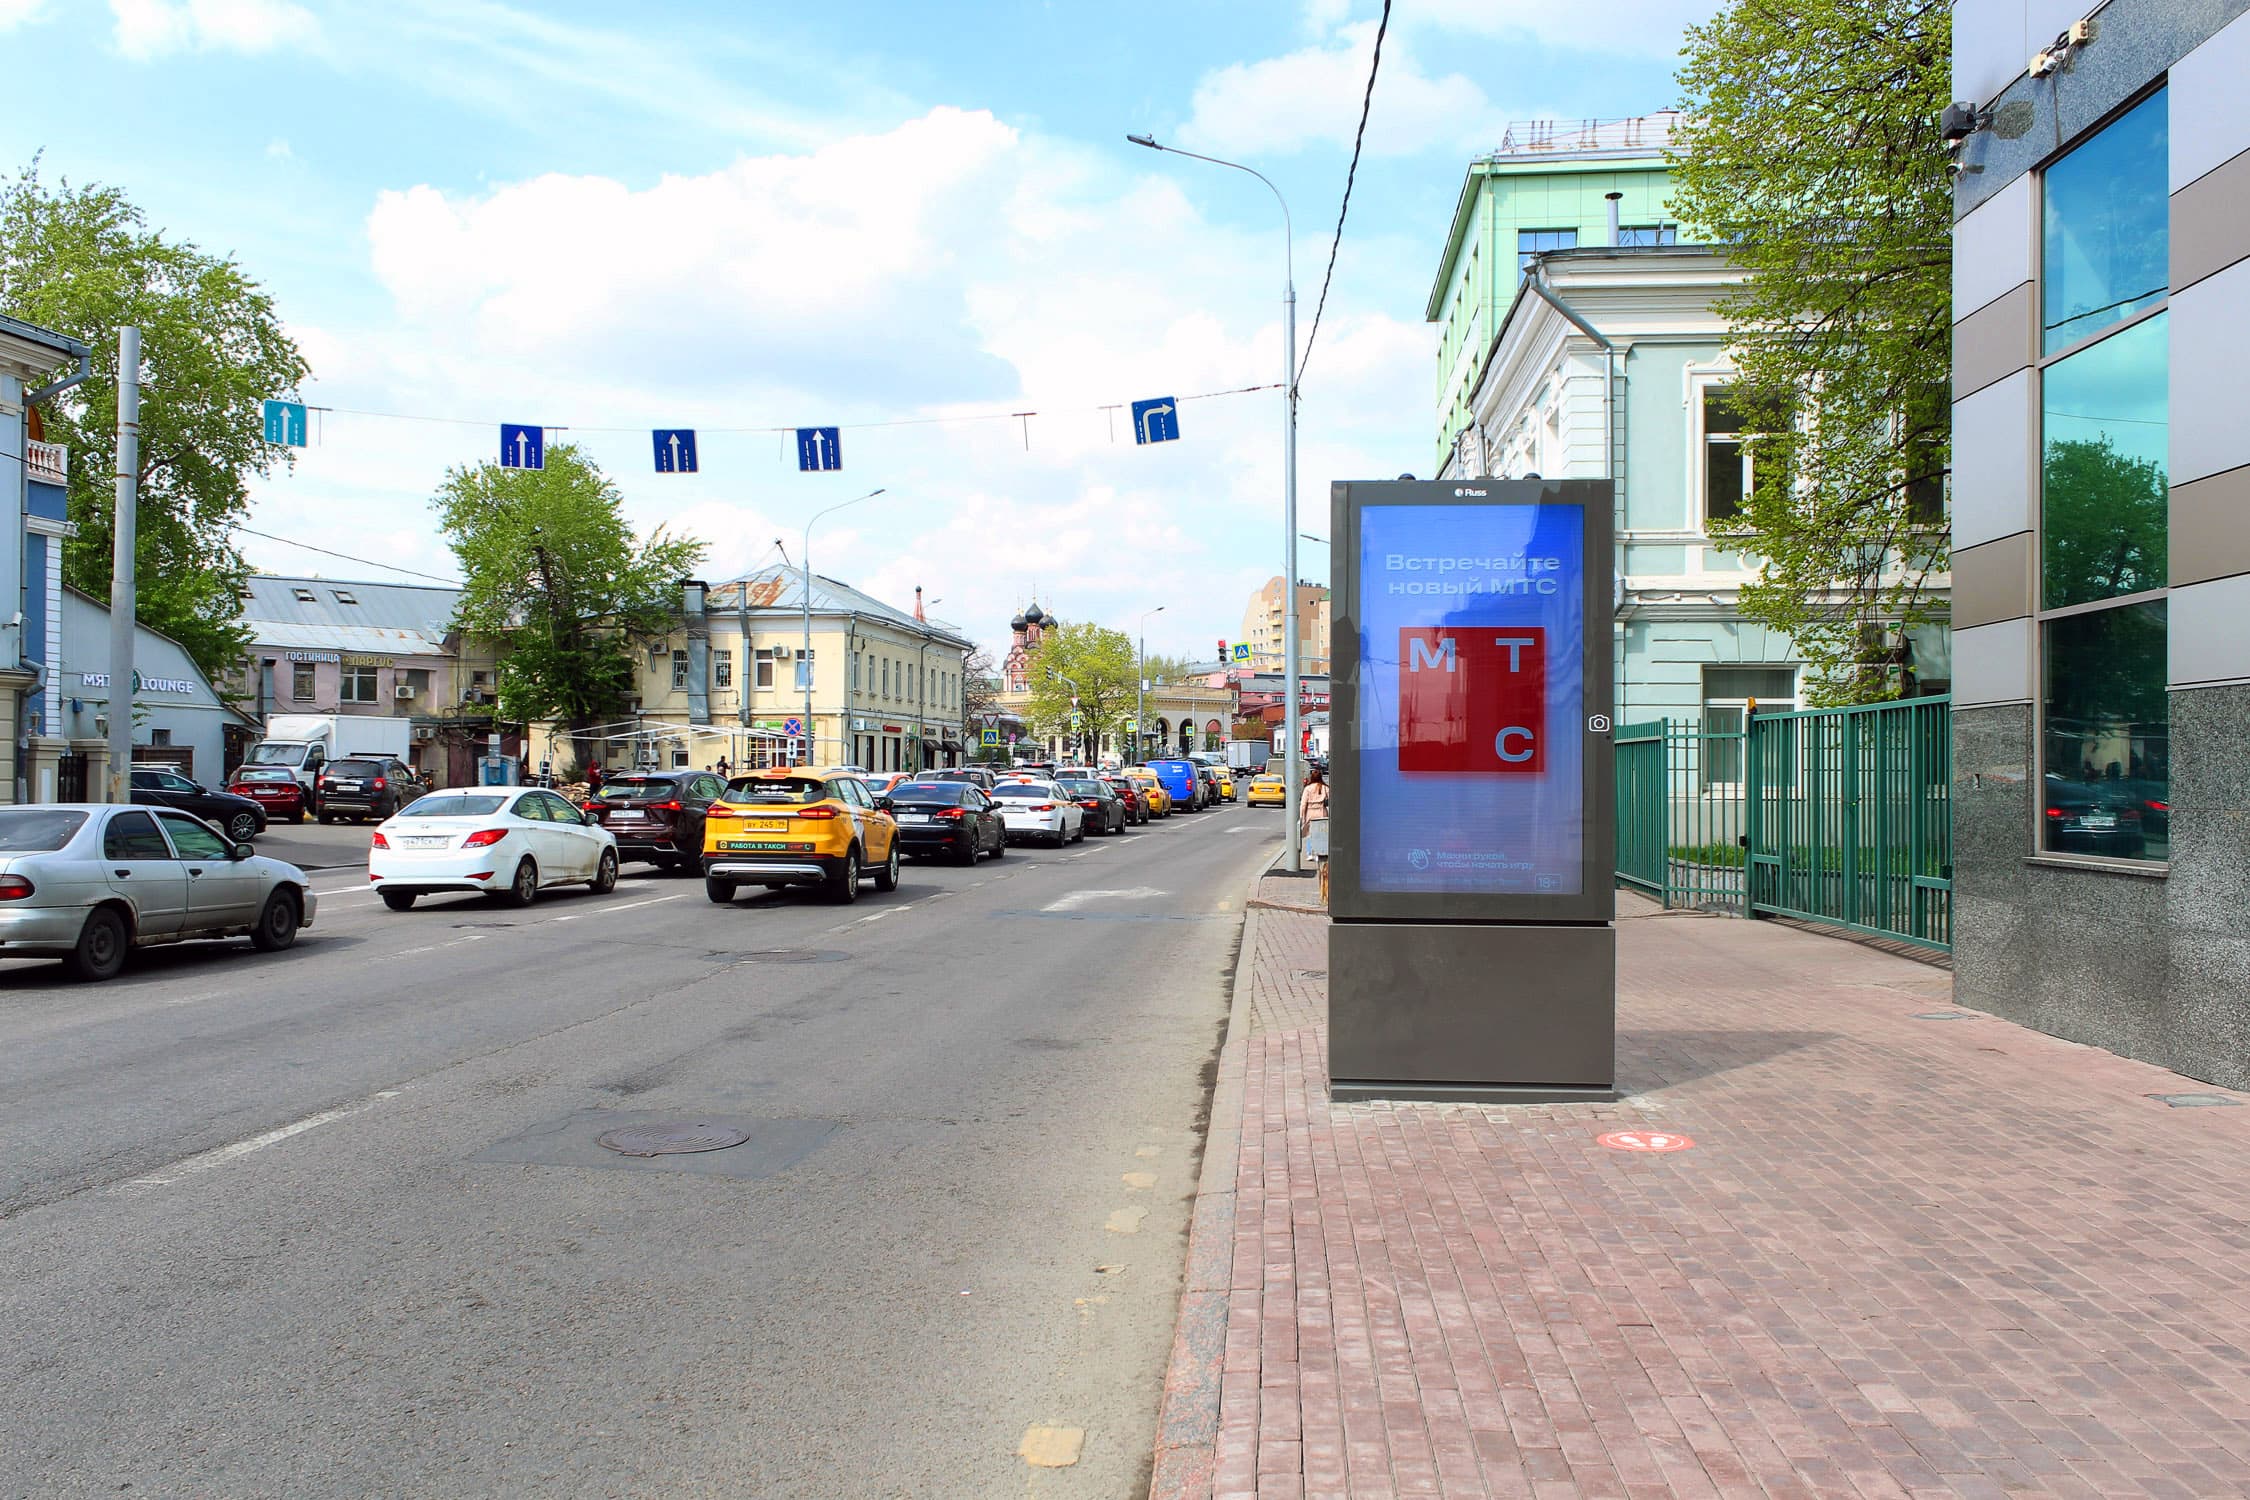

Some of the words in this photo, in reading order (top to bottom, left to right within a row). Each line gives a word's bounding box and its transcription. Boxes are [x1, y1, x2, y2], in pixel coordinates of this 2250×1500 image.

[1464, 488, 1487, 497] Russ
[1385, 552, 1560, 574] Встречайте
[1388, 577, 1483, 595] новый
[1490, 578, 1558, 595] МТС
[285, 651, 340, 664] ГОСТИНИЦА
[82, 673, 110, 687] МЯТ
[141, 678, 193, 693] LOUNGE
[759, 820, 774, 829] 245
[1437, 860, 1469, 869] чтобы
[1471, 861, 1508, 869] начать
[1538, 877, 1557, 888] 18+
